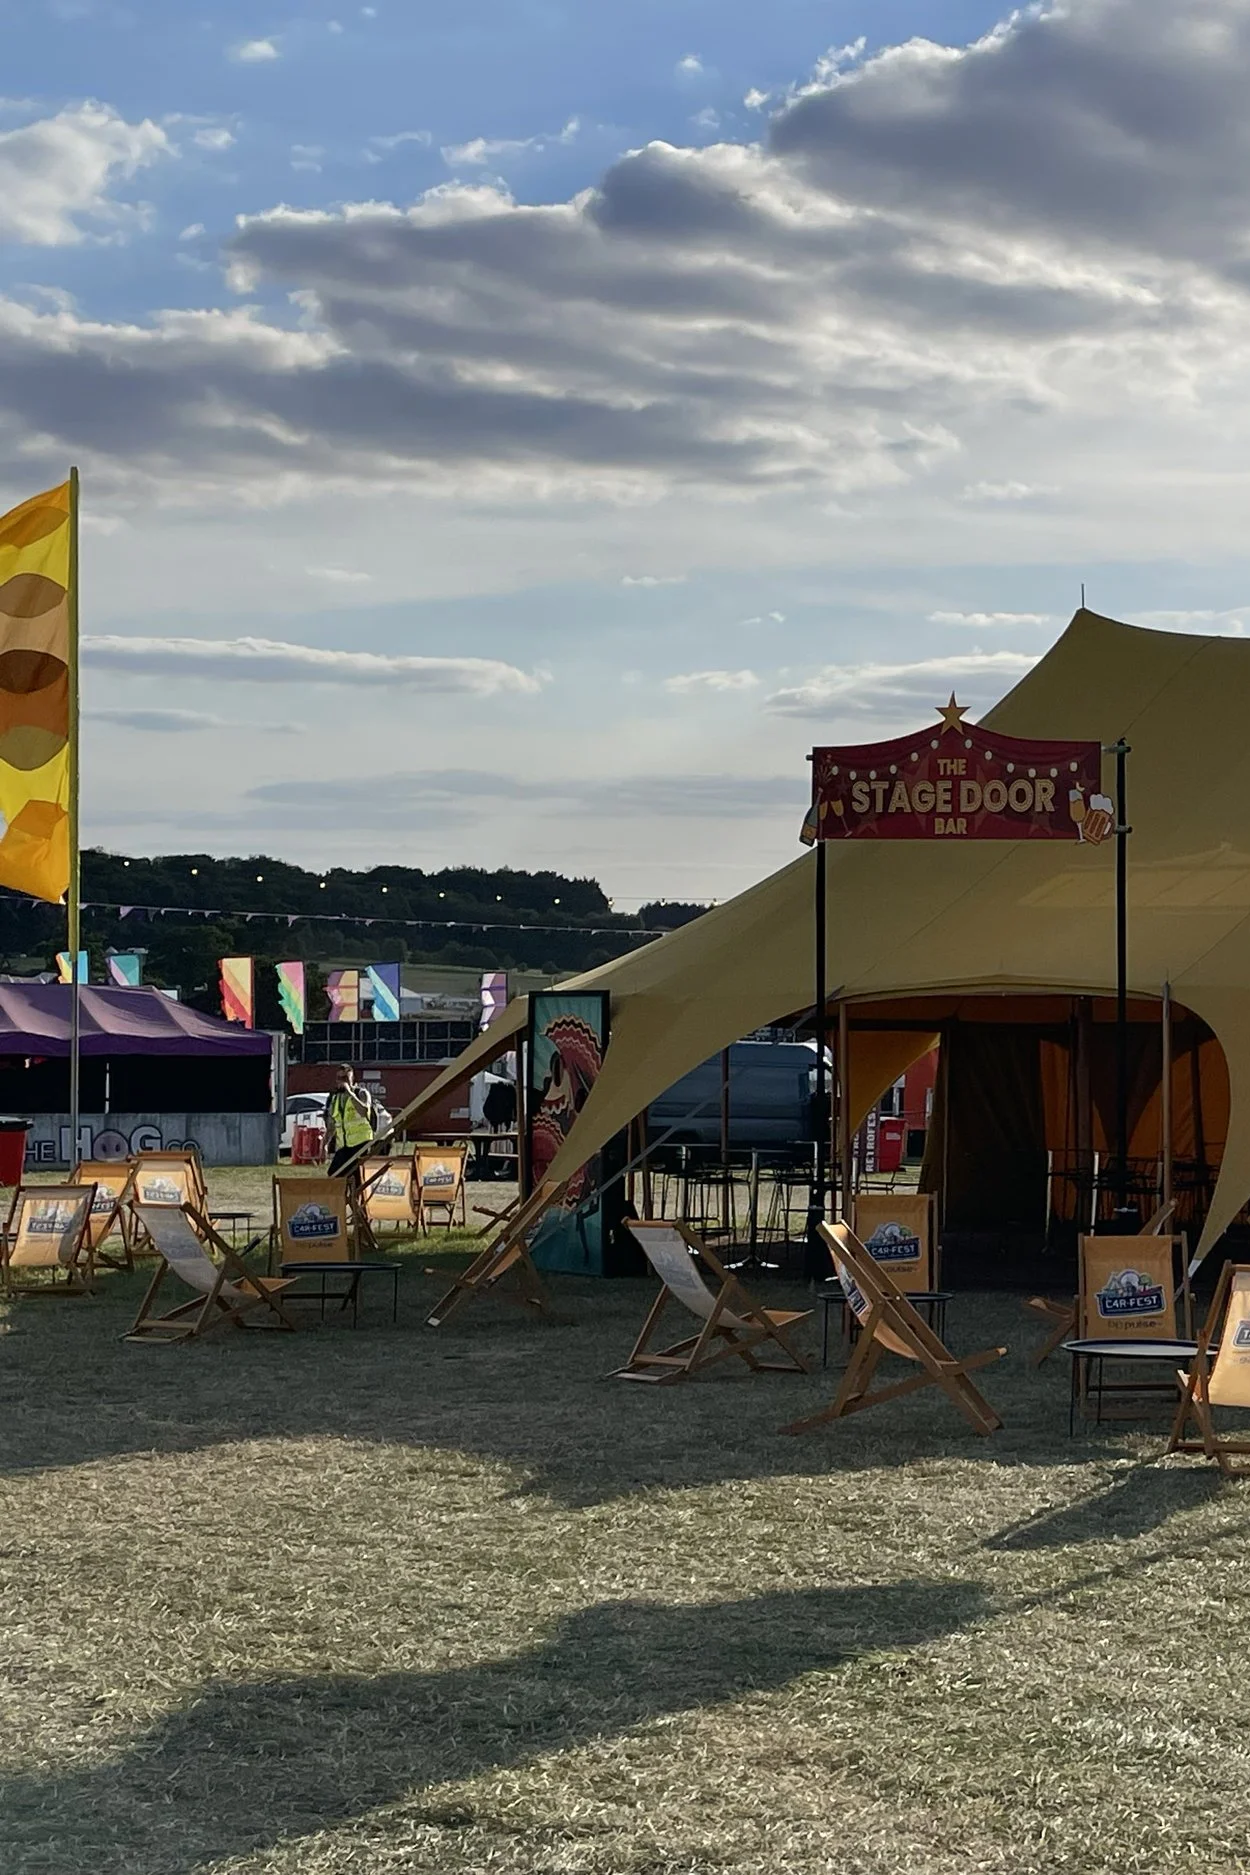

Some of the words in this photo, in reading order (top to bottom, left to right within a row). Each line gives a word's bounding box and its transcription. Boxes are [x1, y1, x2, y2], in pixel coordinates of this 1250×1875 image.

[937, 758, 966, 776] THE
[852, 780, 952, 813] STAGE
[960, 779, 1055, 812] DOOR
[934, 817, 969, 835] BAR
[25, 1140, 56, 1162] HE
